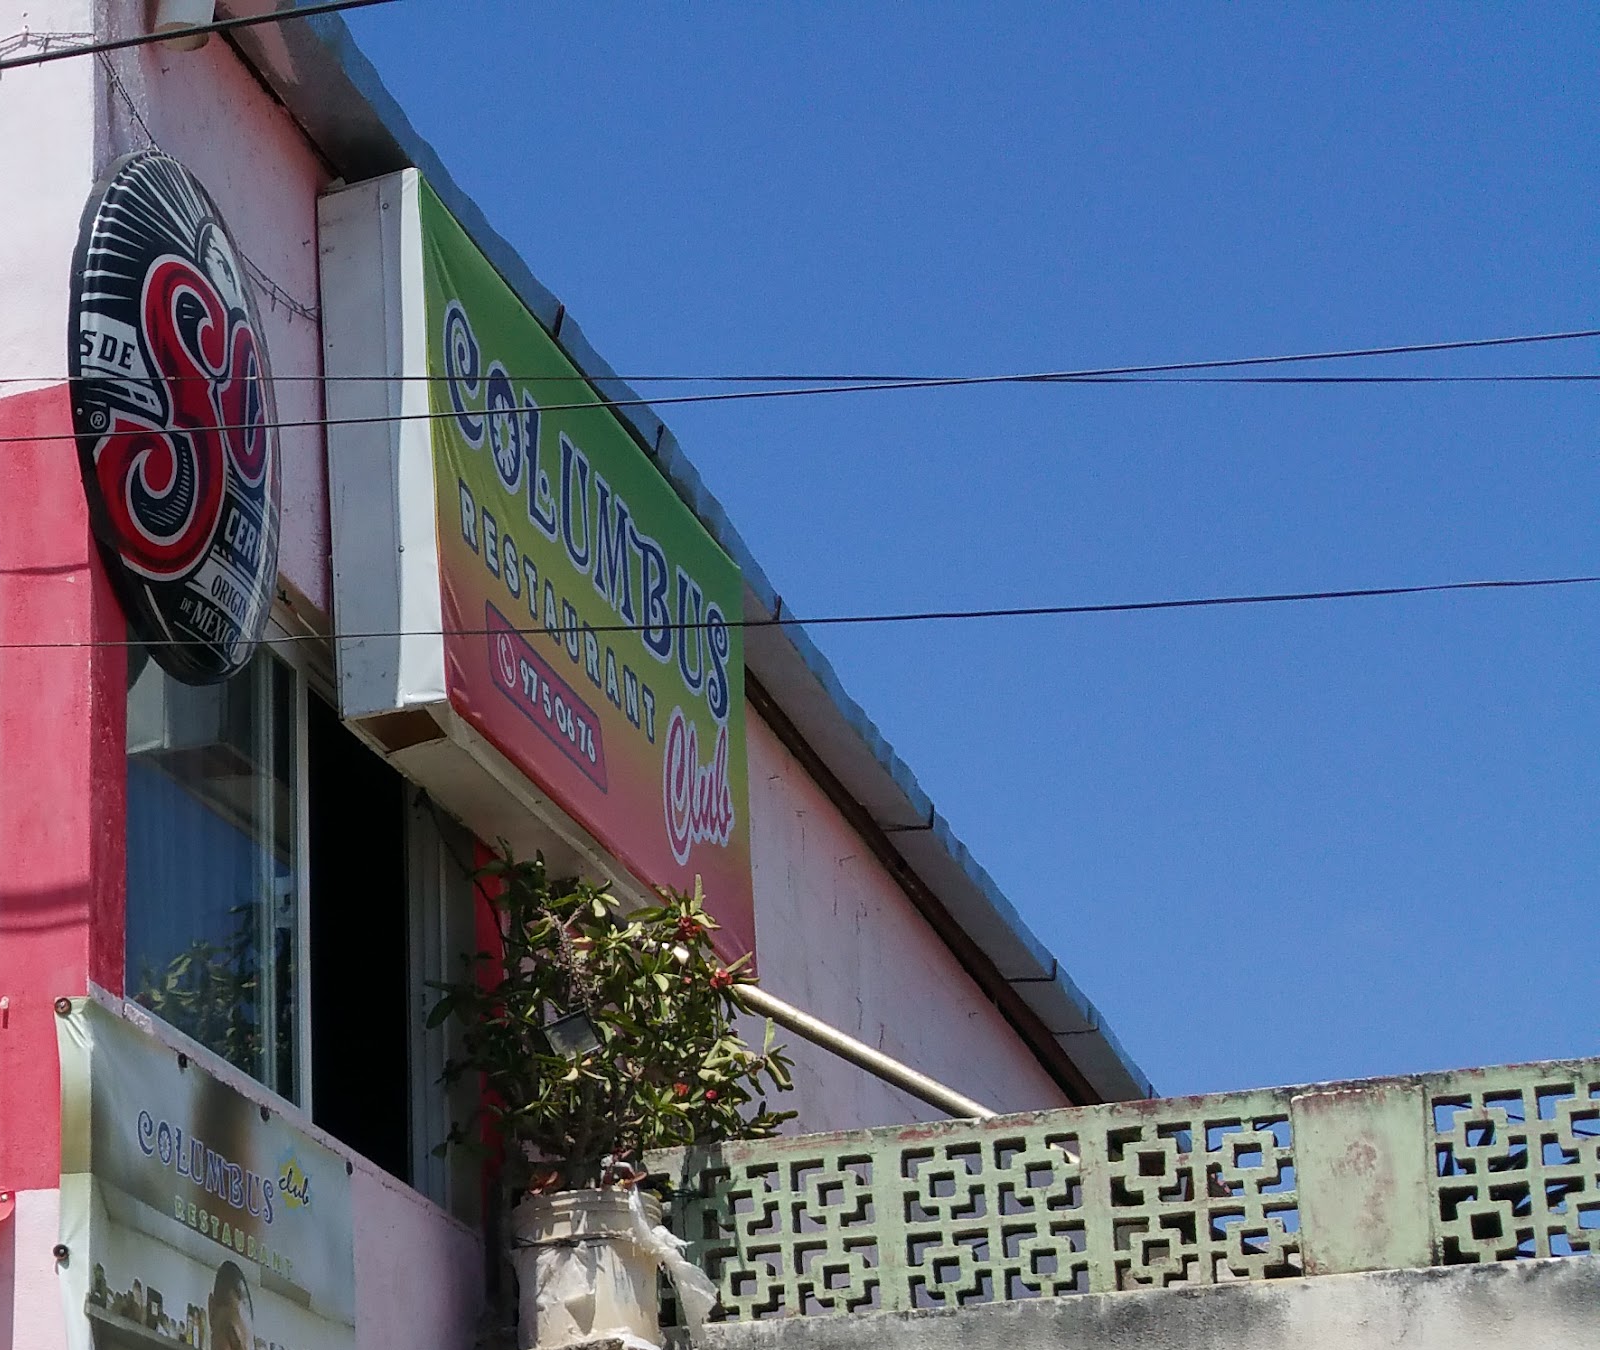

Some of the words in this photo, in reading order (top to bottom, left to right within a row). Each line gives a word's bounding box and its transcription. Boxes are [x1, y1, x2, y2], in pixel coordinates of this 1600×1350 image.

[443, 299, 731, 727] COLUMBUS
[458, 477, 657, 744] RESTAURANT
[519, 658, 538, 704] 97
[541, 681, 552, 719] 5
[554, 695, 575, 742] 06
[576, 716, 596, 763] 76
[662, 703, 734, 866] Club
[137, 1109, 274, 1224] COLUMBUS
[278, 1167, 310, 1206] club
[173, 1194, 293, 1280] RESTAURANT
